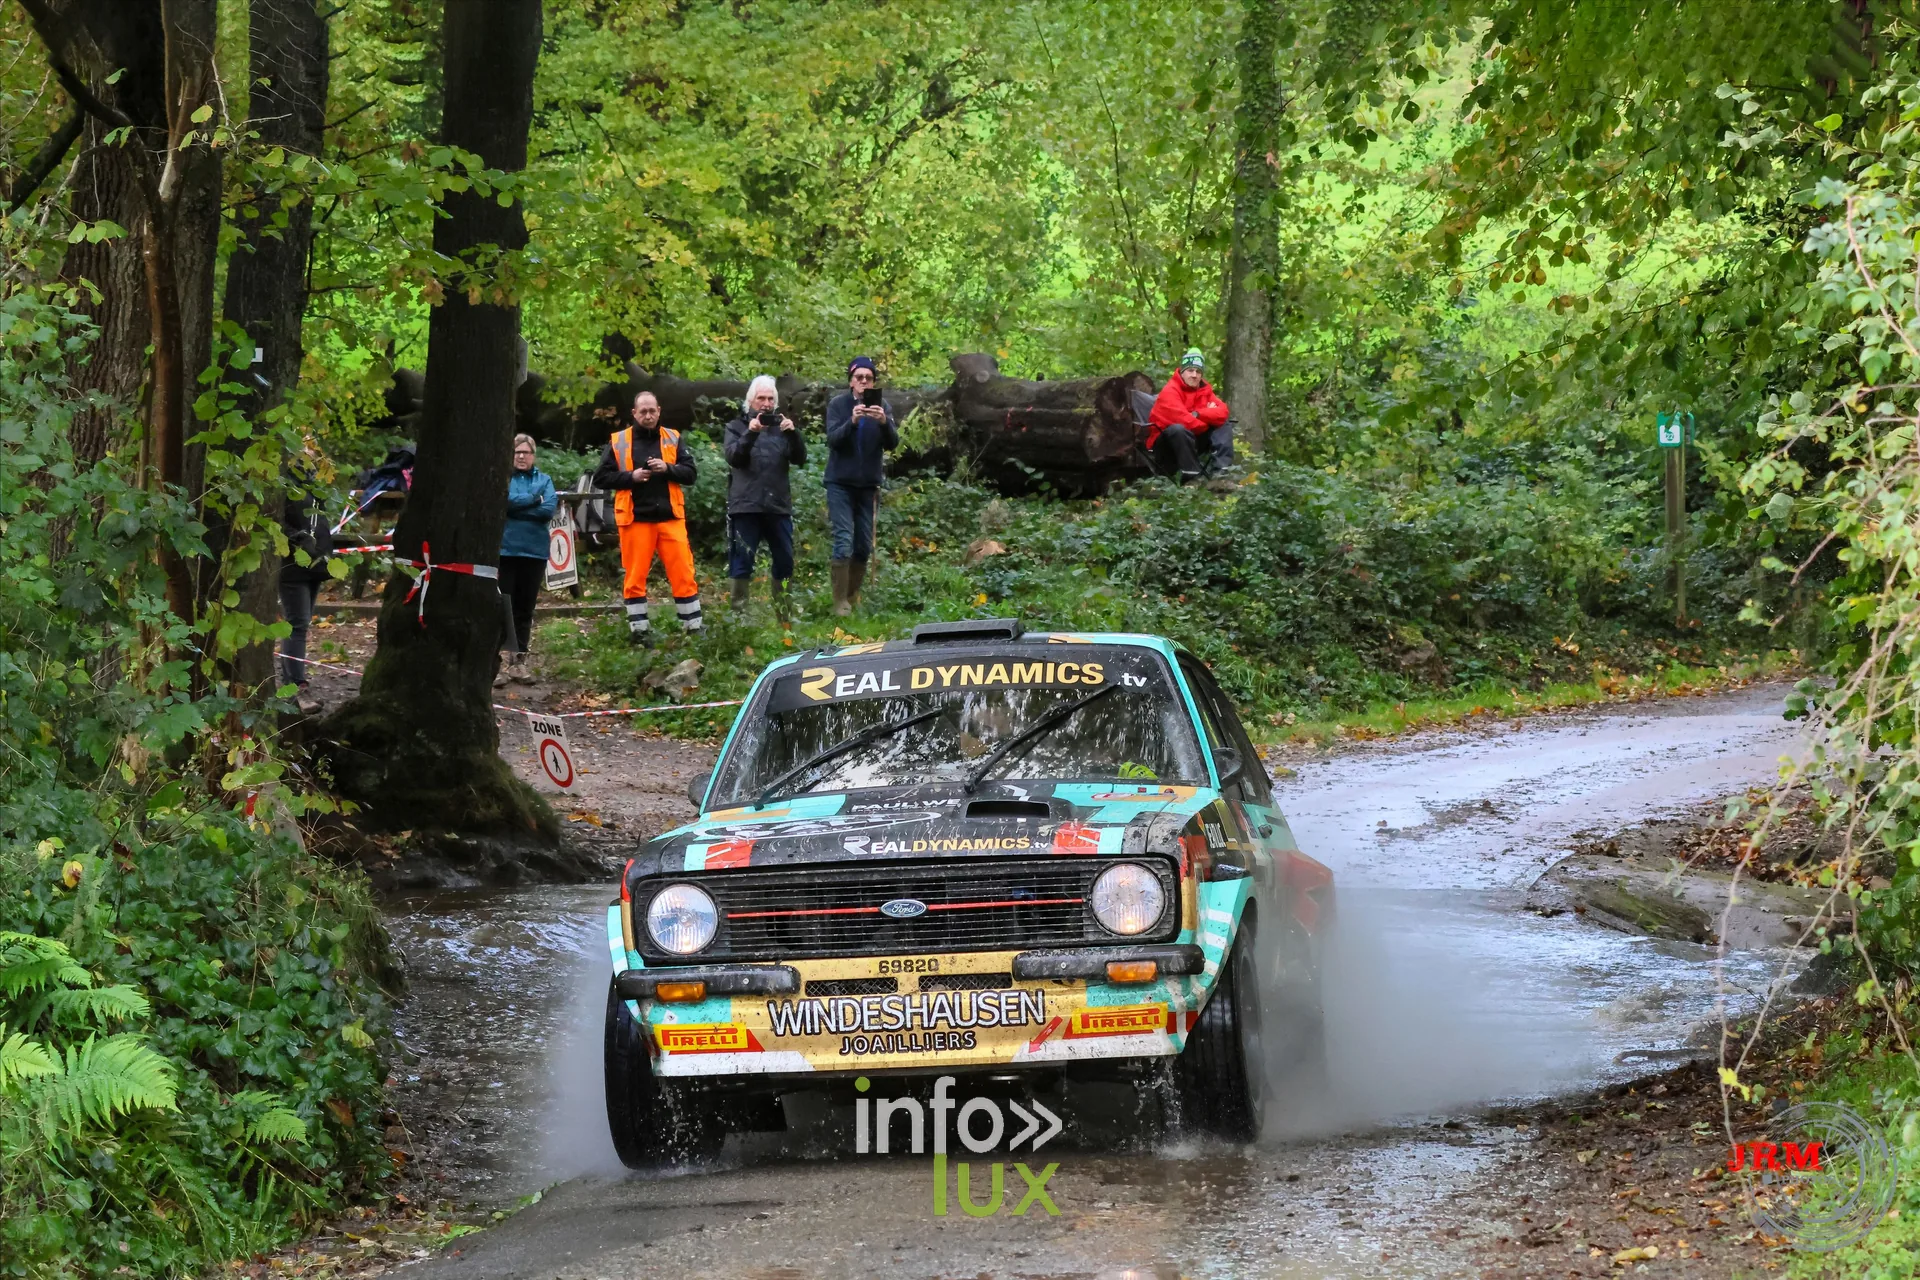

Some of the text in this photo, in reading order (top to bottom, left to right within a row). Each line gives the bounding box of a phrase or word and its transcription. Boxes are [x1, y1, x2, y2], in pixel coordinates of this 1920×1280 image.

[549, 516, 568, 530] ONE
[801, 667, 901, 701] REAL
[911, 662, 1105, 690] DYNAMICS
[532, 720, 563, 737] ZONE
[891, 902, 916, 914] Ford
[878, 958, 940, 975] 69820
[767, 987, 1046, 1037] WINDESHAUSEN
[1081, 1007, 1160, 1029] PIRELLI
[661, 1027, 738, 1047] PIRELLI
[839, 1031, 977, 1055] JOAILLIERS
